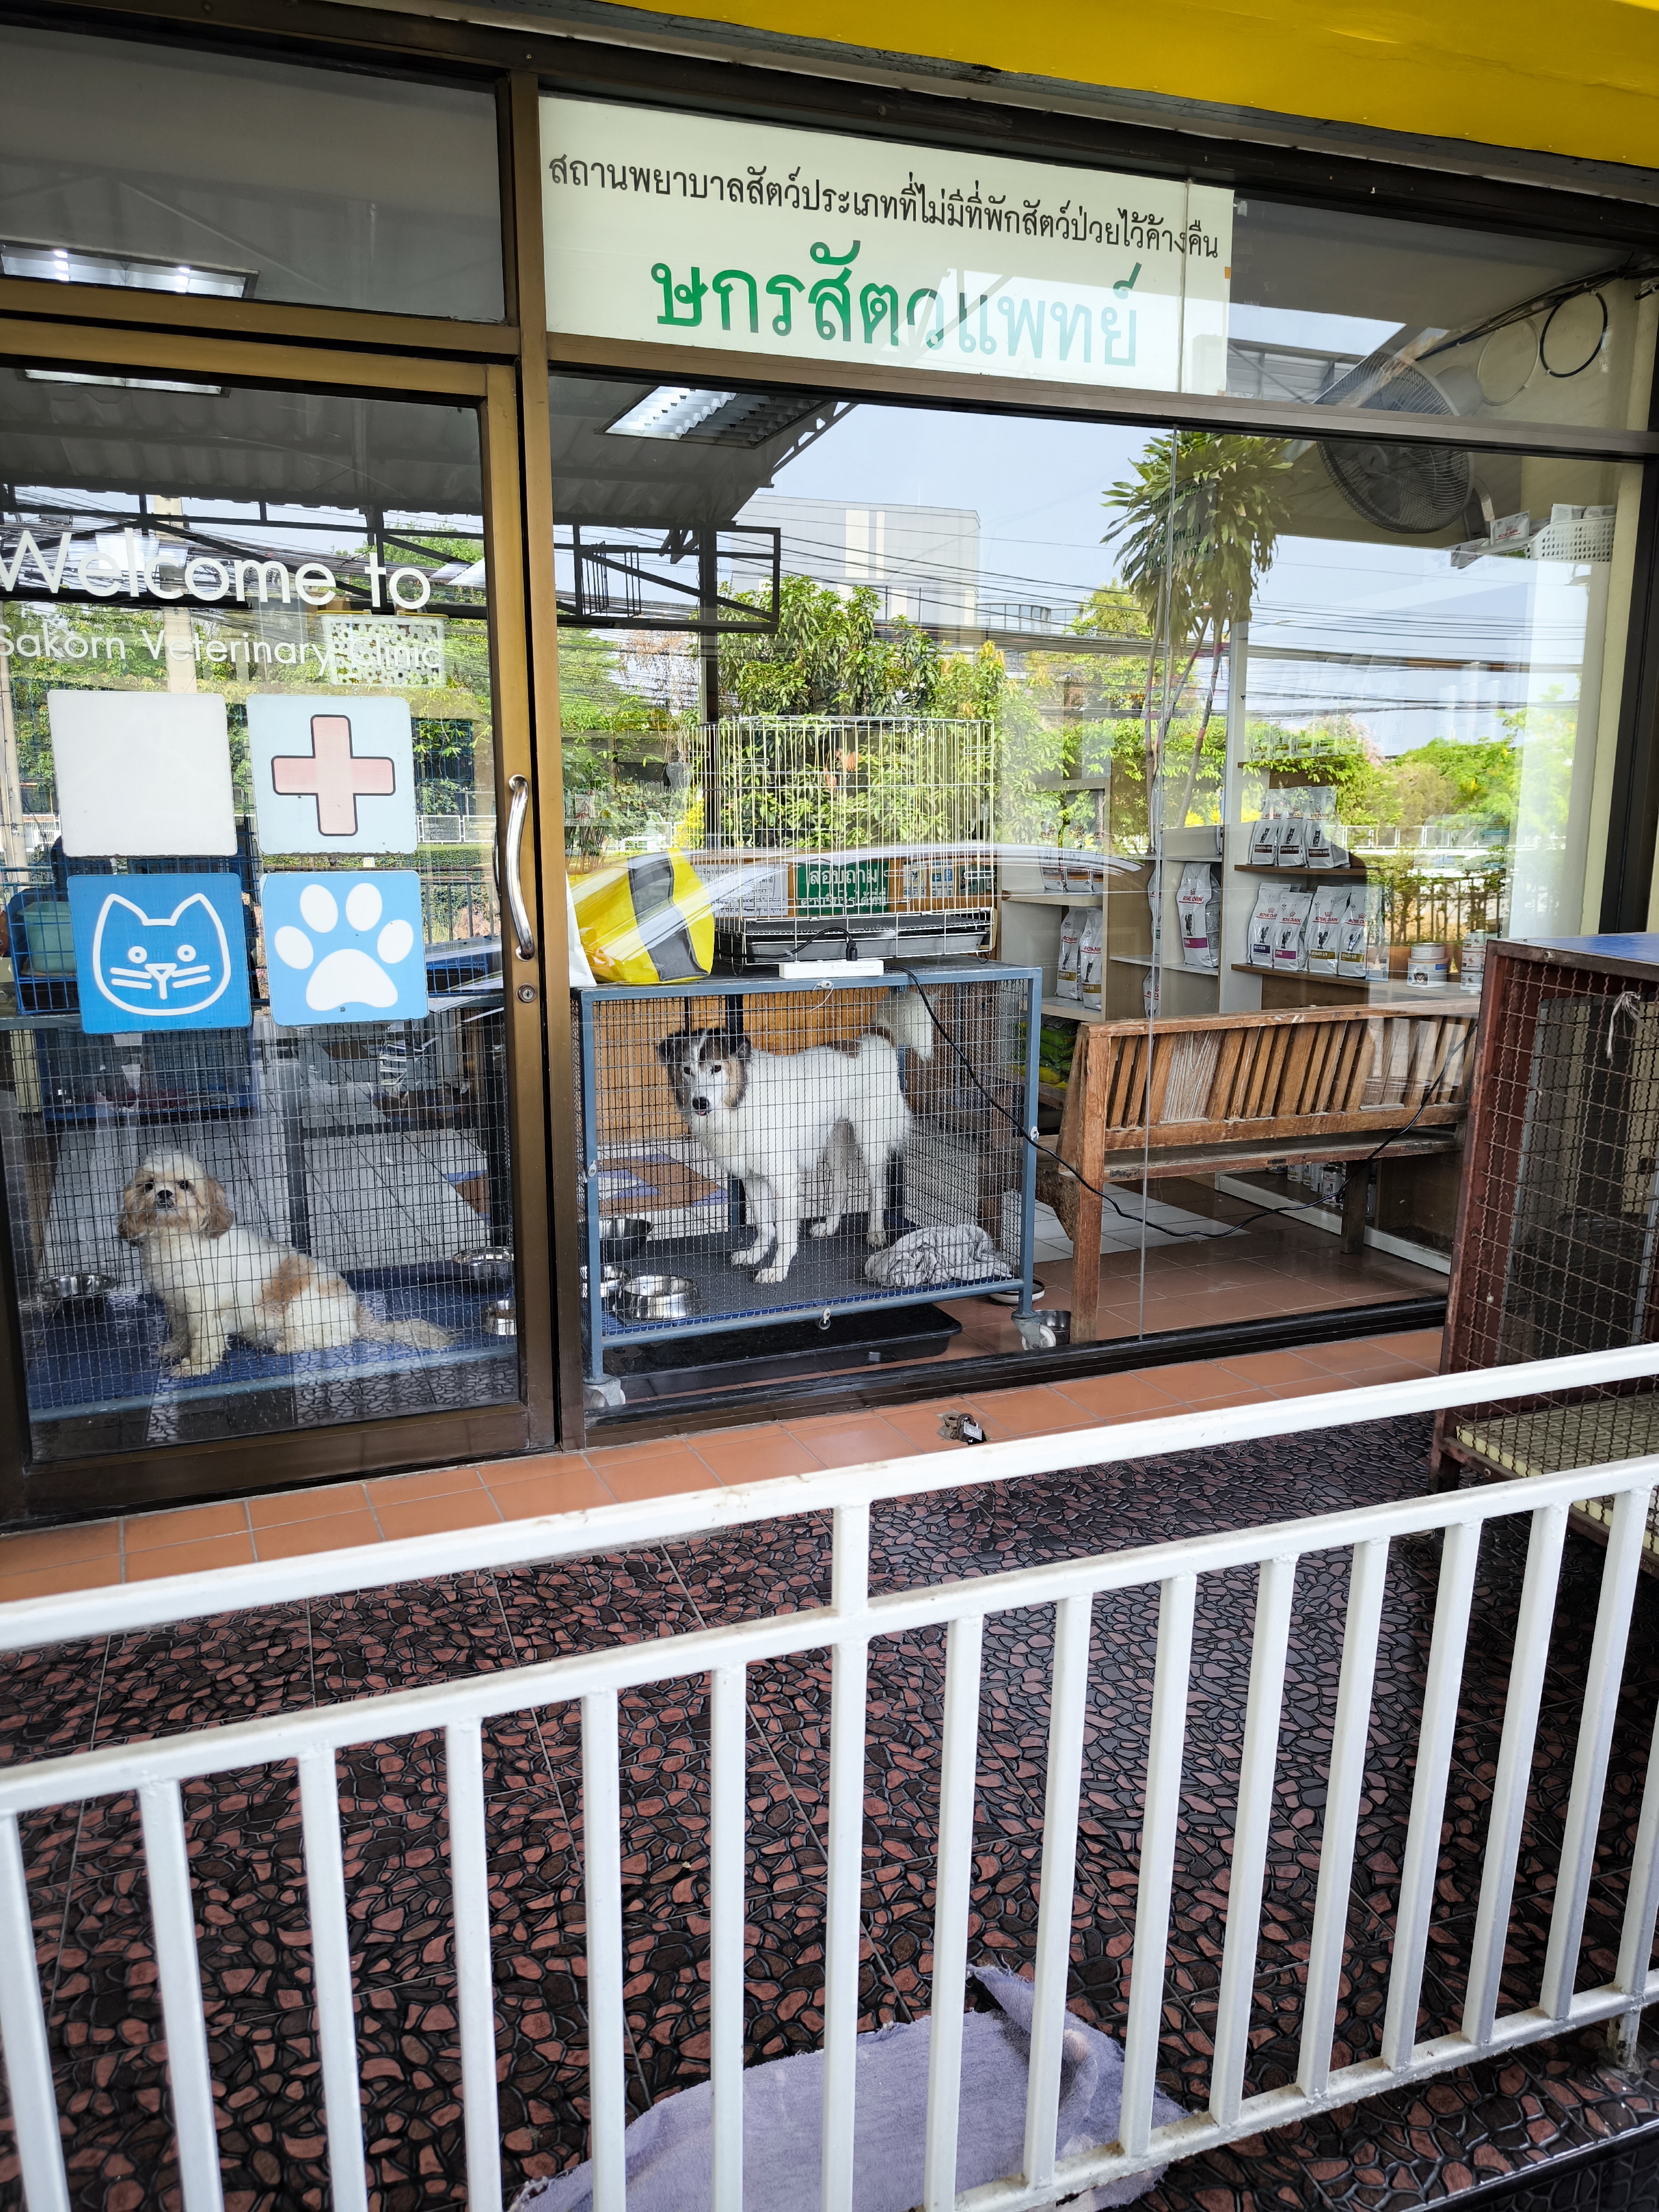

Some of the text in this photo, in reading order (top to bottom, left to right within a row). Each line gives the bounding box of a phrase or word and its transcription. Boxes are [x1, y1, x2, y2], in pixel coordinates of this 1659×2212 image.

[650, 239, 1142, 368] ษกรสัตวแพทย์
[0, 528, 431, 610] Welcome to
[0, 623, 442, 677] Sakorn Veterinary Clinic
